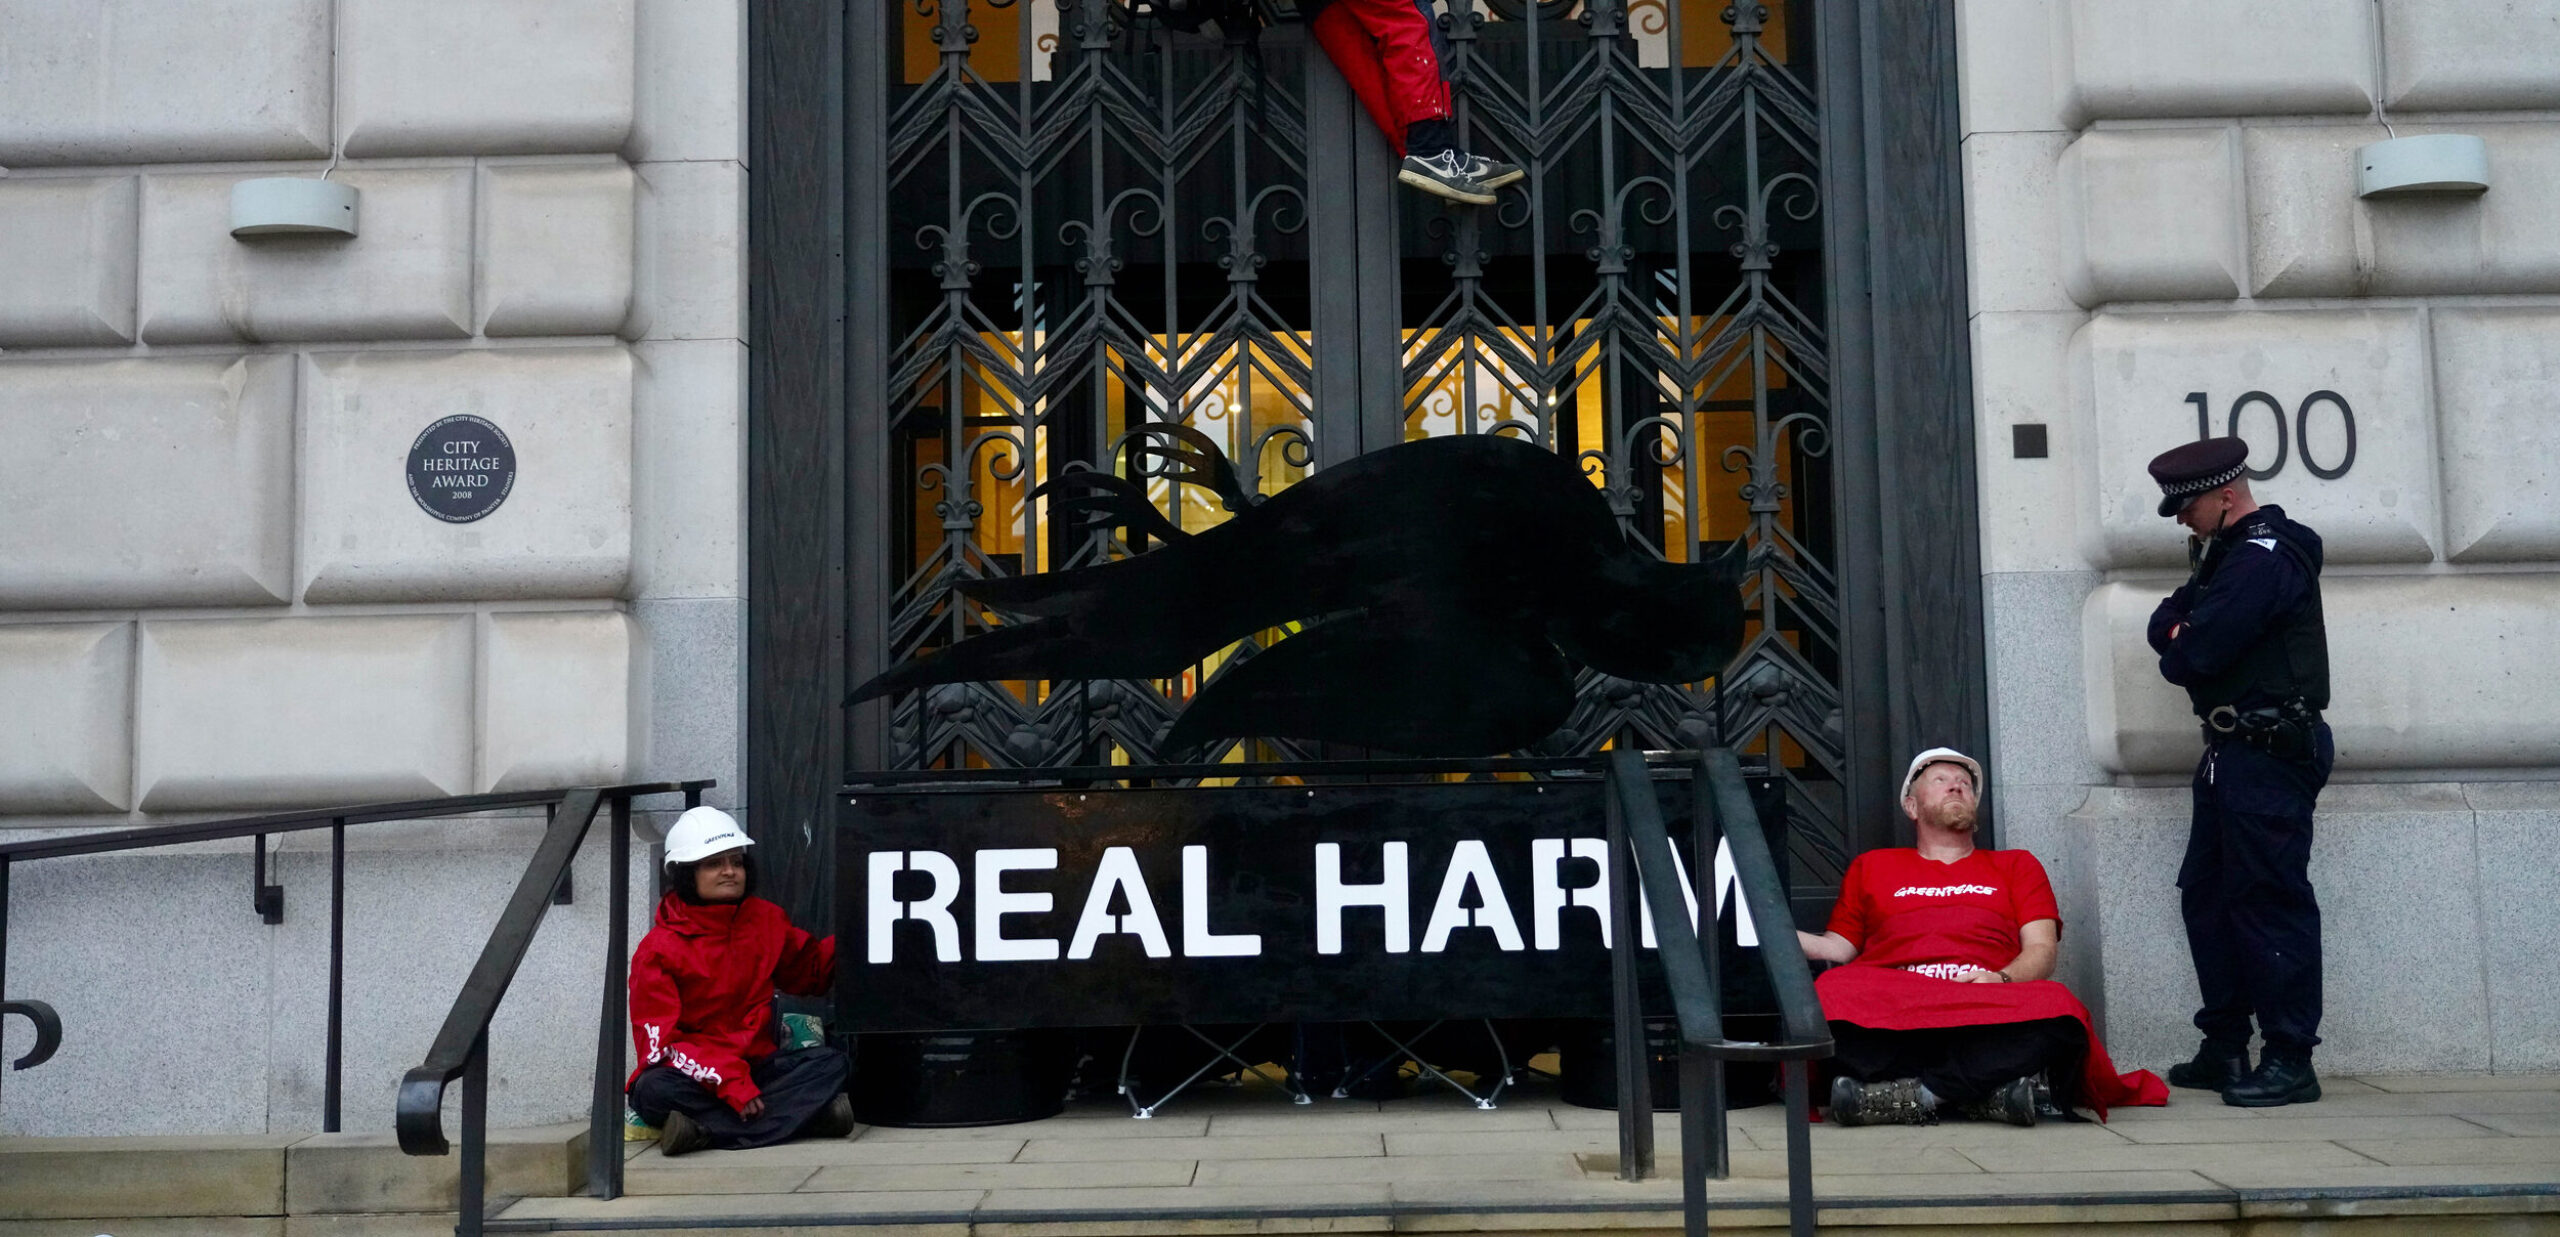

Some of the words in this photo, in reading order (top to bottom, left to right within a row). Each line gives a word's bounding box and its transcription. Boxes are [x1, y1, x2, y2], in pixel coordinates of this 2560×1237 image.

[413, 425, 436, 450] PRESENTED
[469, 416, 495, 431] HERITAGE
[493, 428, 509, 448] SOCIETY
[2184, 390, 2357, 481] 100
[443, 441, 480, 454] CITY
[423, 457, 500, 471] HERITAGE
[432, 474, 489, 488] AWARD
[411, 485, 420, 498] THE
[452, 491, 473, 500] 2008
[1893, 884, 1998, 898] GREENPEACE
[867, 845, 1262, 964] REAL
[1315, 835, 1761, 955] HARM
